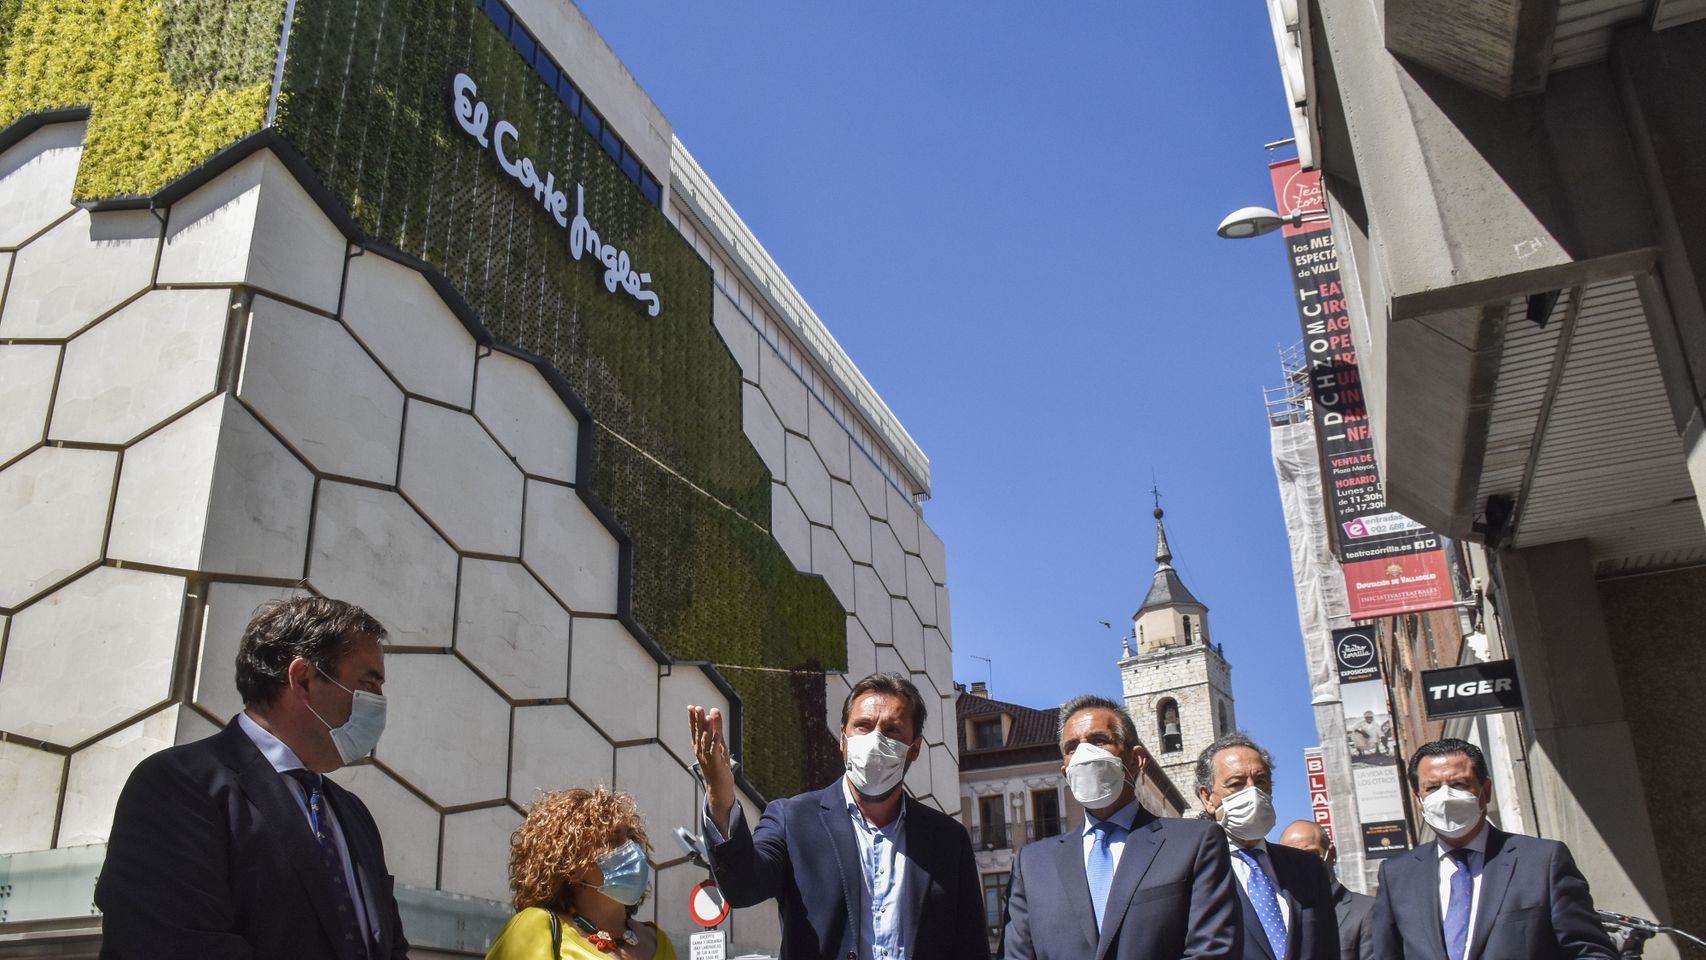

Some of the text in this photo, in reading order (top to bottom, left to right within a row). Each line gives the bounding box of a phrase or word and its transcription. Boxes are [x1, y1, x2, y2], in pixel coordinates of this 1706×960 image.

[454, 73, 660, 316] El Corte Inglés
[1293, 244, 1309, 253] los
[1331, 456, 1359, 467] VENTA
[1360, 454, 1372, 463] DE
[1335, 475, 1377, 488] HORARIO
[1336, 487, 1364, 497] Lunes
[1346, 544, 1412, 559] teatrozorrilla.es
[1429, 678, 1512, 700] TIGER
